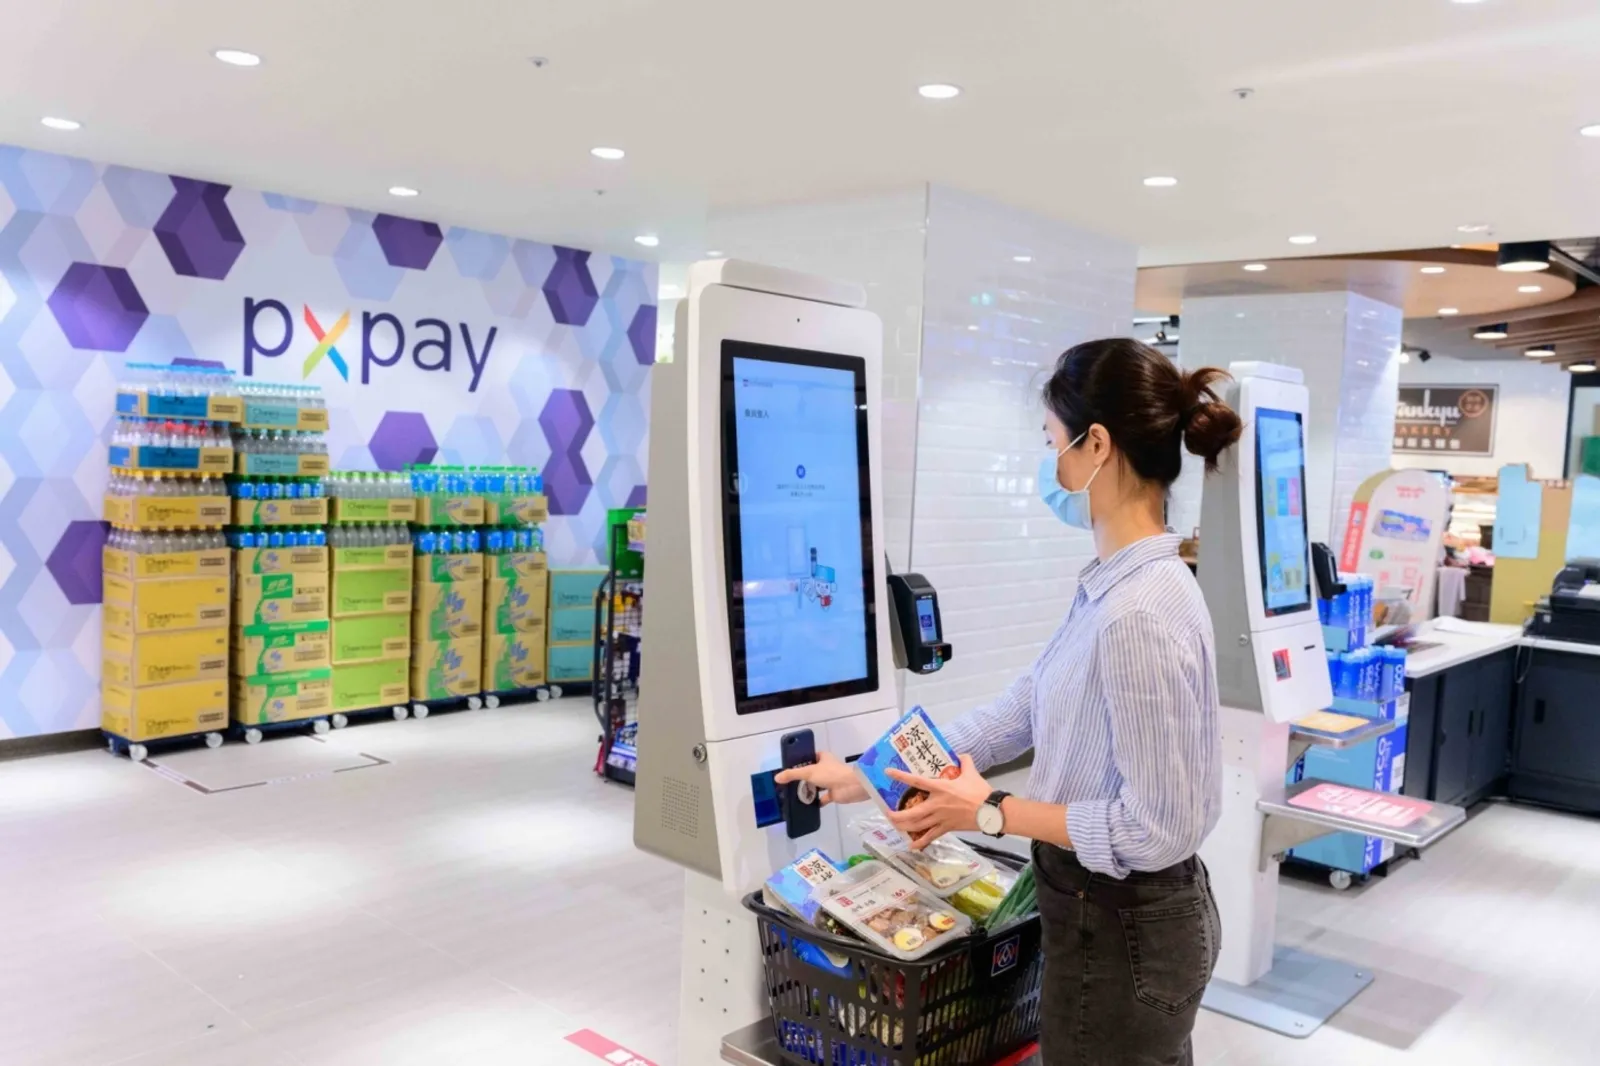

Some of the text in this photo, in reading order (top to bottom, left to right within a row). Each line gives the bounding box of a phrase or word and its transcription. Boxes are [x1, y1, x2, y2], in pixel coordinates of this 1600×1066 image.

[243, 297, 498, 393] pxpay
[1396, 389, 1461, 427] ankyu
[1396, 425, 1451, 436] AKERY
[905, 724, 947, 777] 涼拌菜
[1374, 736, 1388, 793] ZICO
[1363, 835, 1376, 868] ZIC
